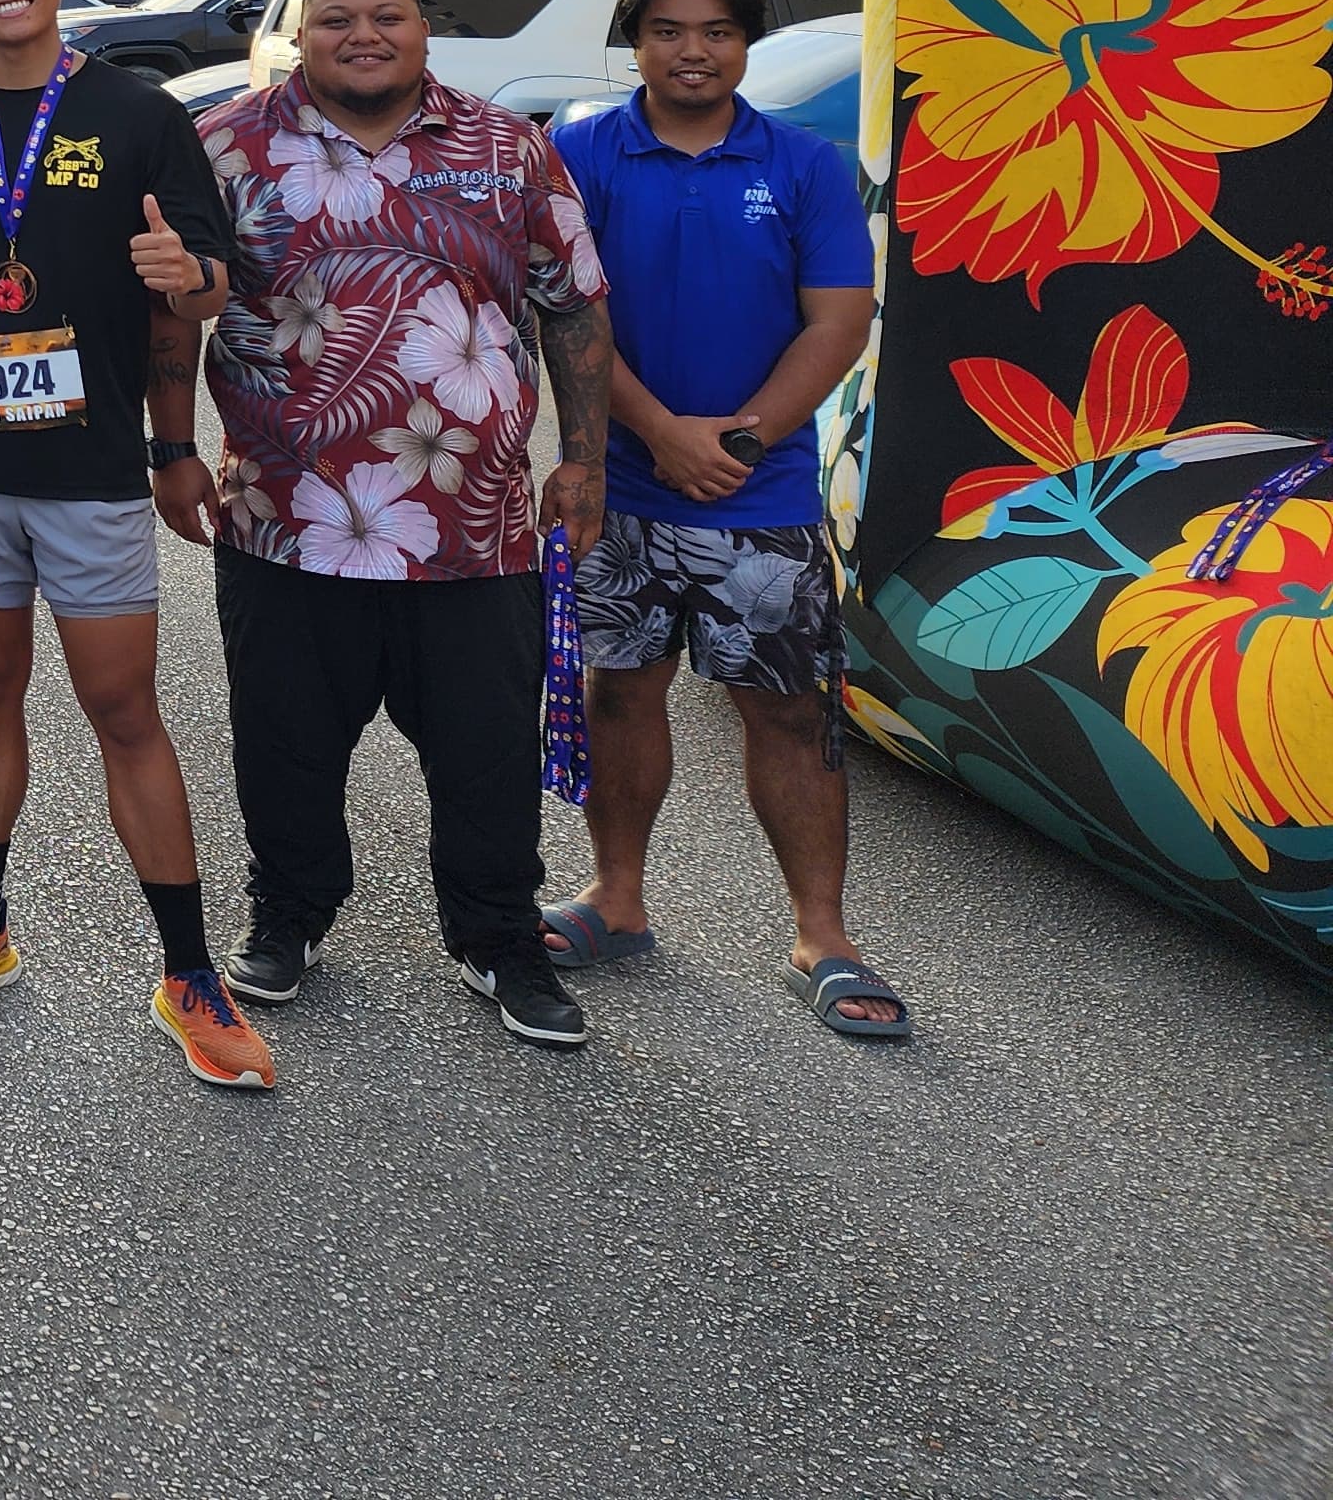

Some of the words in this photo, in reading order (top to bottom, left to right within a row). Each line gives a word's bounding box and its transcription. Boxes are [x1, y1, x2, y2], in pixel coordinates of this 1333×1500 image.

[46, 171, 74, 186] MP
[78, 172, 99, 189] CO
[5, 402, 67, 422] SAIPAN
